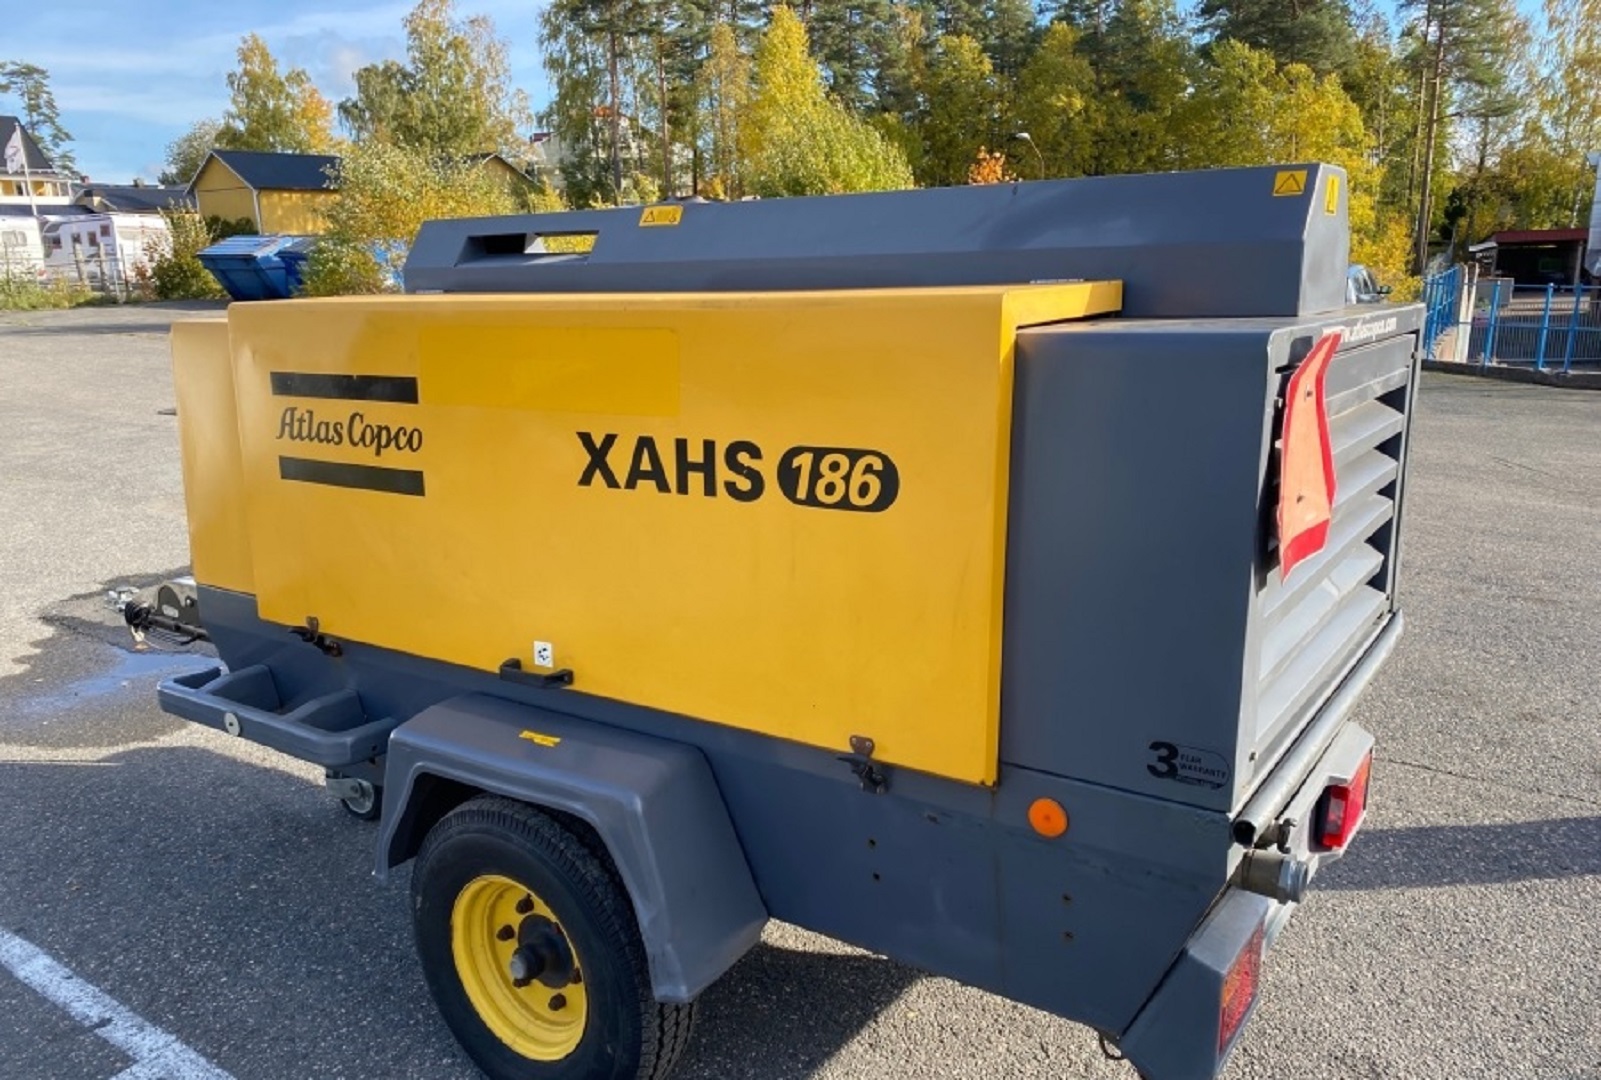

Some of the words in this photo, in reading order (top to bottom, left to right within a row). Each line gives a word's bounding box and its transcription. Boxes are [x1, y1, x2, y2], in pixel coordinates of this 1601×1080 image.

[276, 406, 344, 446] Atlas
[346, 410, 423, 458] Copco
[575, 431, 766, 503] XAHS
[790, 451, 884, 507] 186
[1146, 741, 1179, 779] 3
